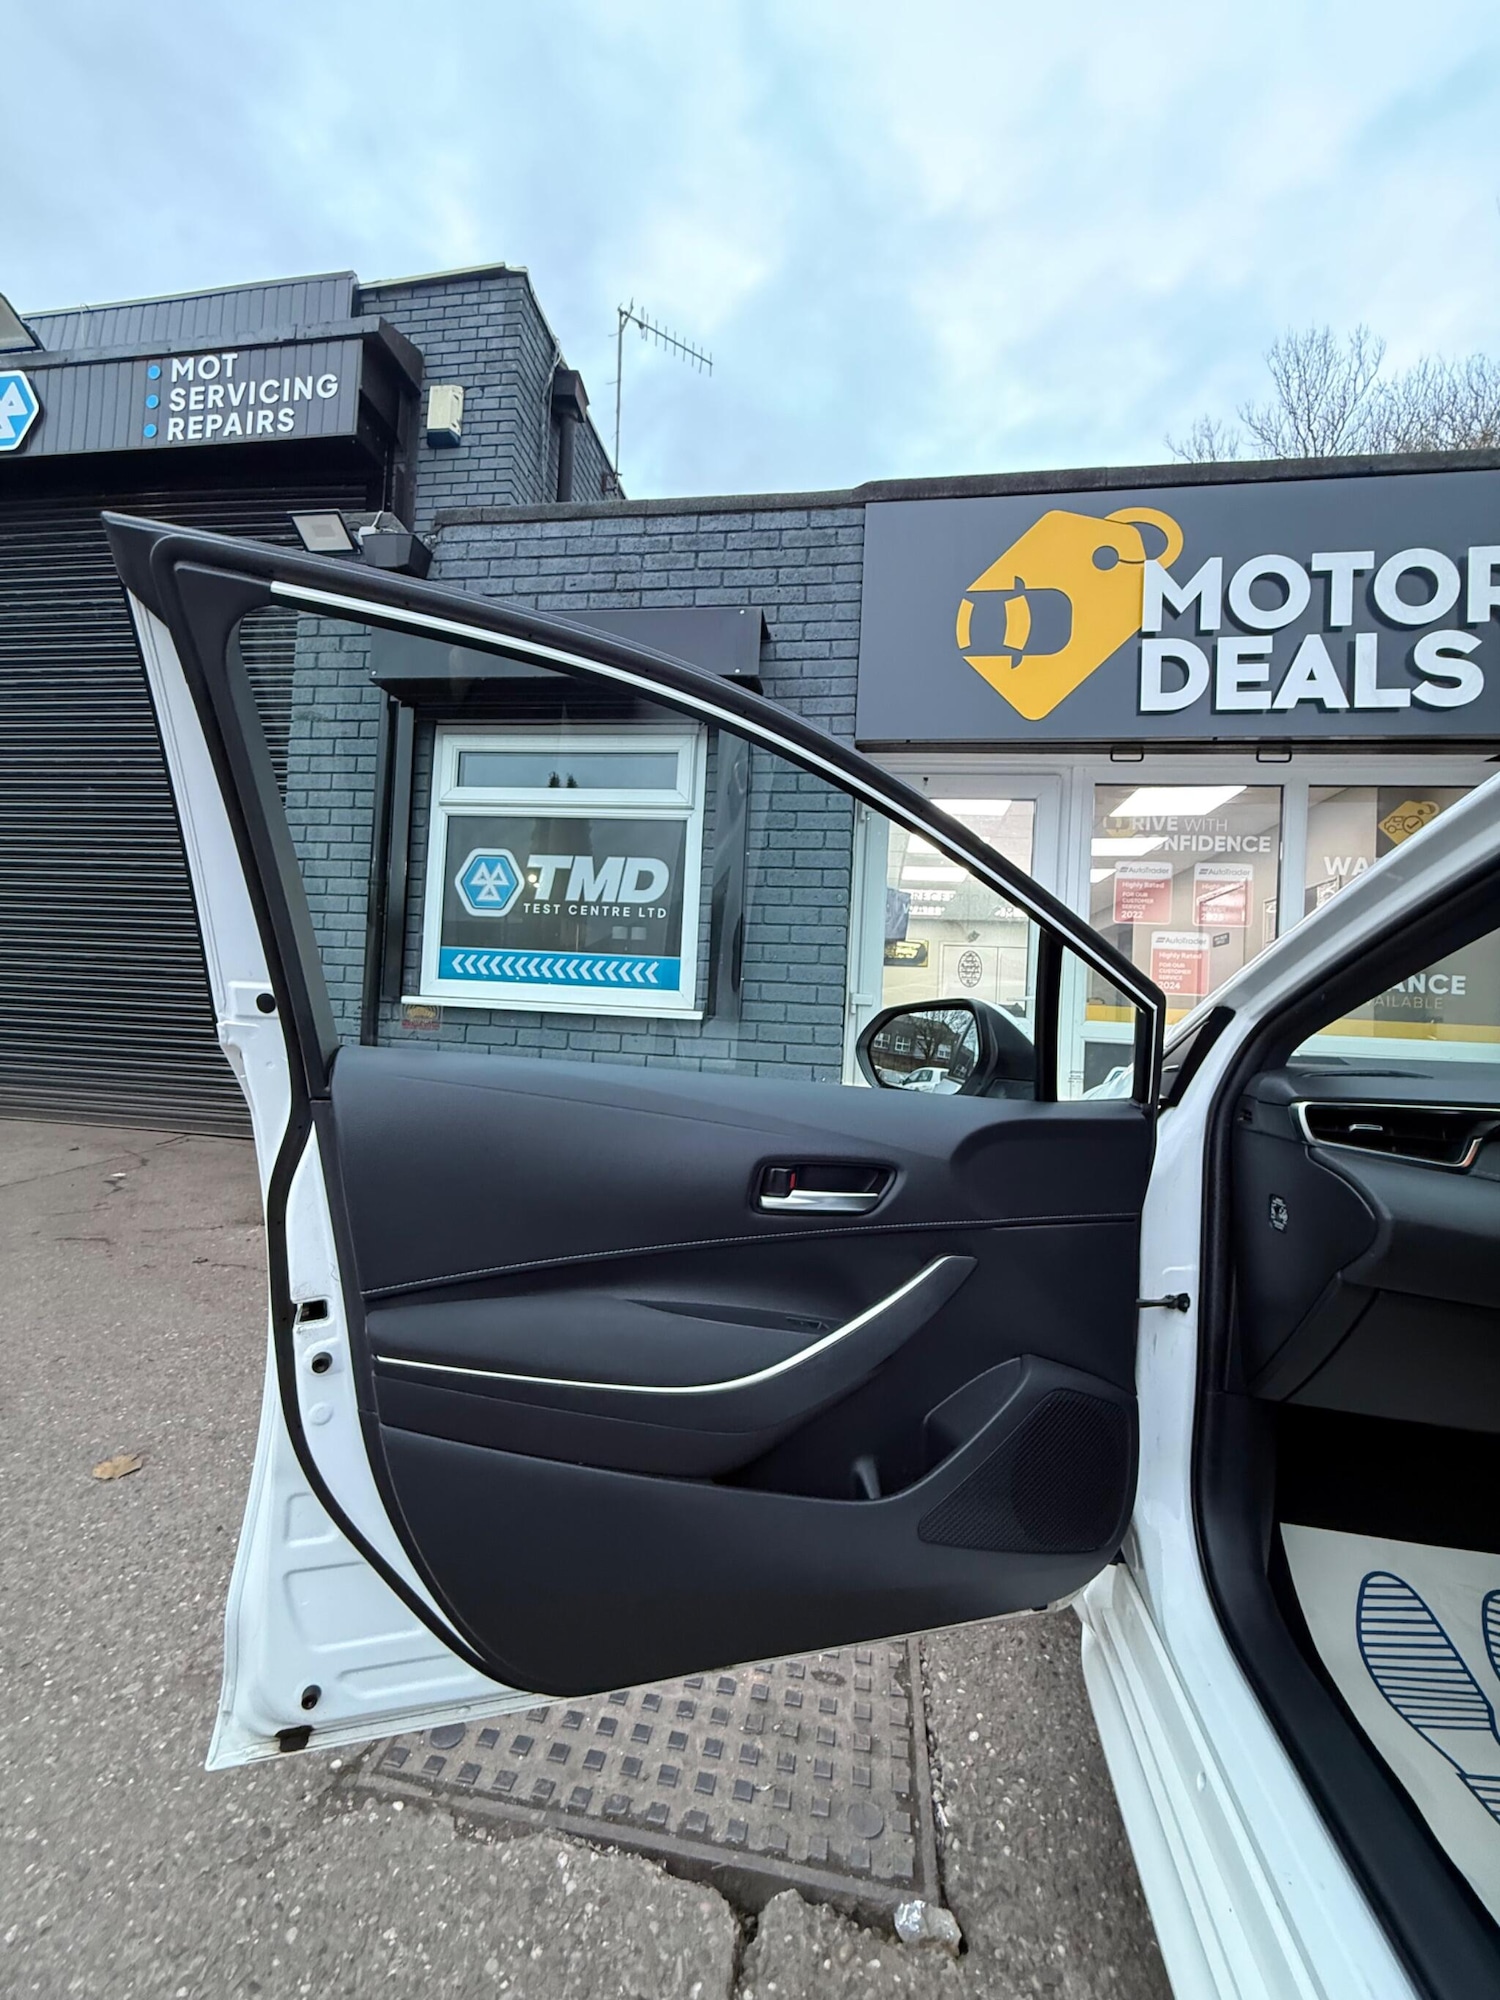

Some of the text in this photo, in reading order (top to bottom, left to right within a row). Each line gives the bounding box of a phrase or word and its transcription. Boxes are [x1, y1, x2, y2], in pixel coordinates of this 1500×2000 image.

[171, 353, 238, 382] MOT
[169, 373, 338, 412] SERVICING
[167, 407, 295, 441] REPAIRS
[1140, 629, 1485, 711] DEALS
[1184, 819, 1228, 832] WITH
[1133, 835, 1271, 852] NFIDENCE
[1324, 856, 1383, 876] WA
[527, 854, 670, 903] TMD
[523, 903, 667, 918] TEST CENTRE LTD
[1121, 911, 1144, 919] 2022
[1164, 937, 1207, 945] AutoTrader
[1158, 981, 1181, 990] 2024
